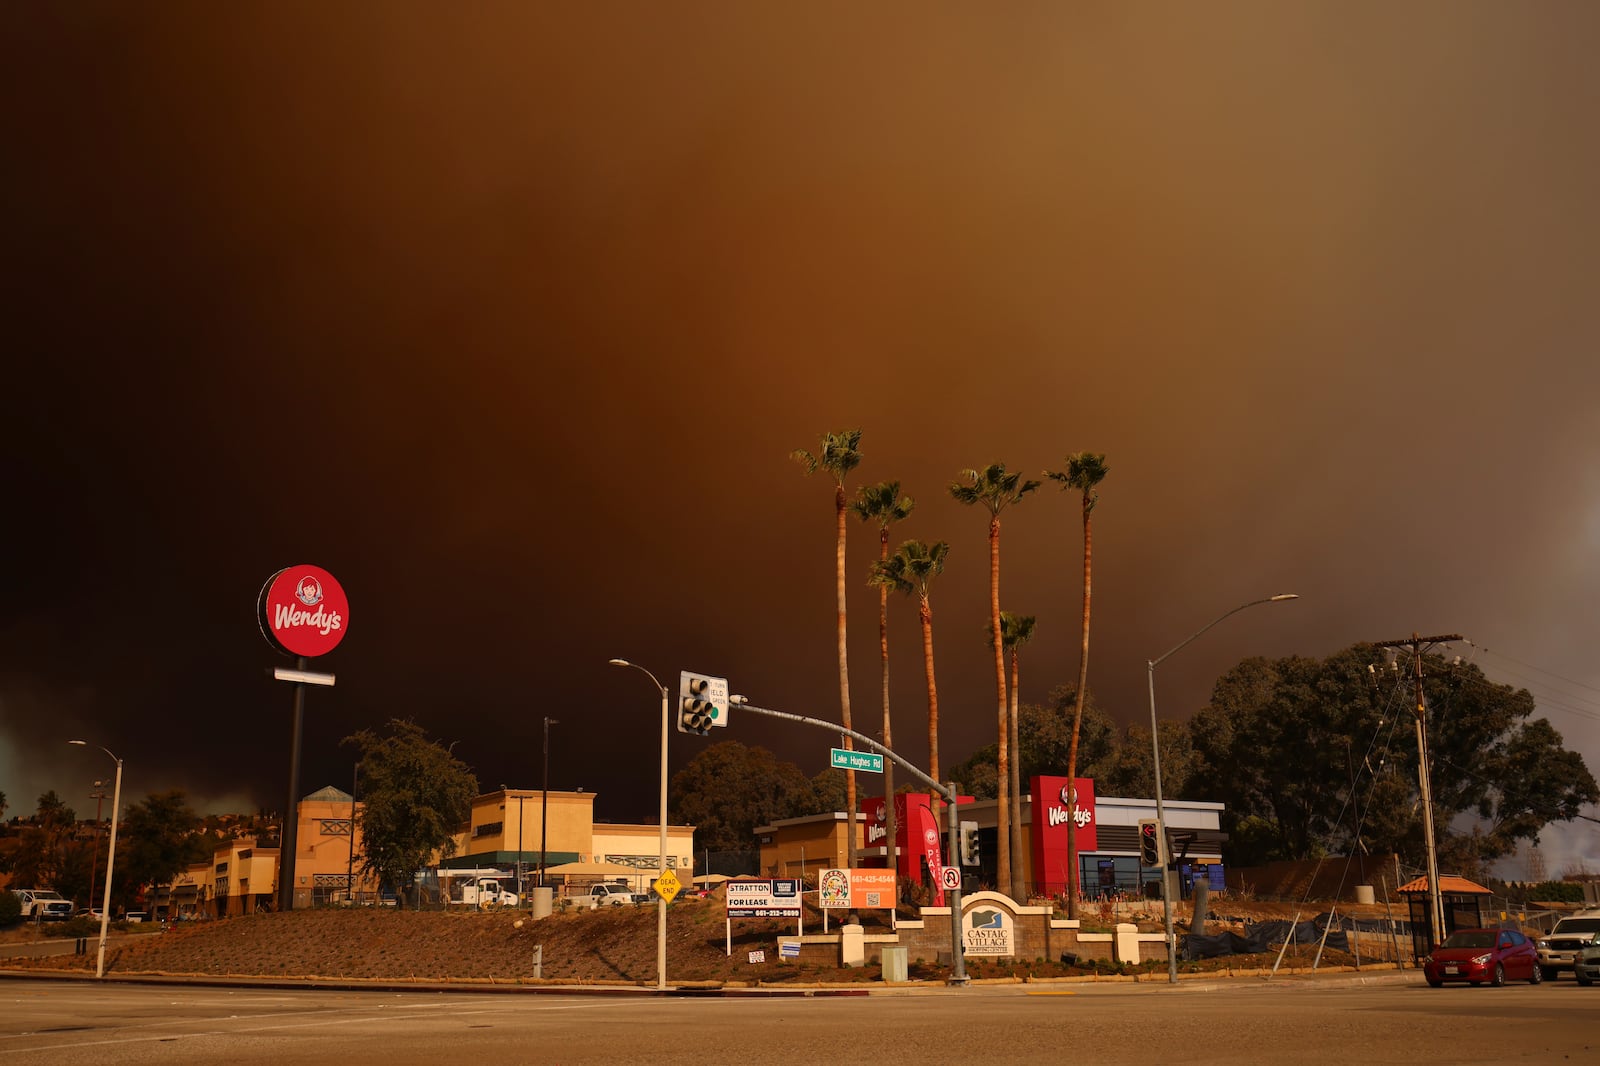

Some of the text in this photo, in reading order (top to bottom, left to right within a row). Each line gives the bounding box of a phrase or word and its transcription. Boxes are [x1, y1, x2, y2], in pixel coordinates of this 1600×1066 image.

[275, 603, 341, 635] Wendy's
[834, 753, 880, 768] Lake Hughes Rd
[968, 930, 1008, 938] CASTAIC
